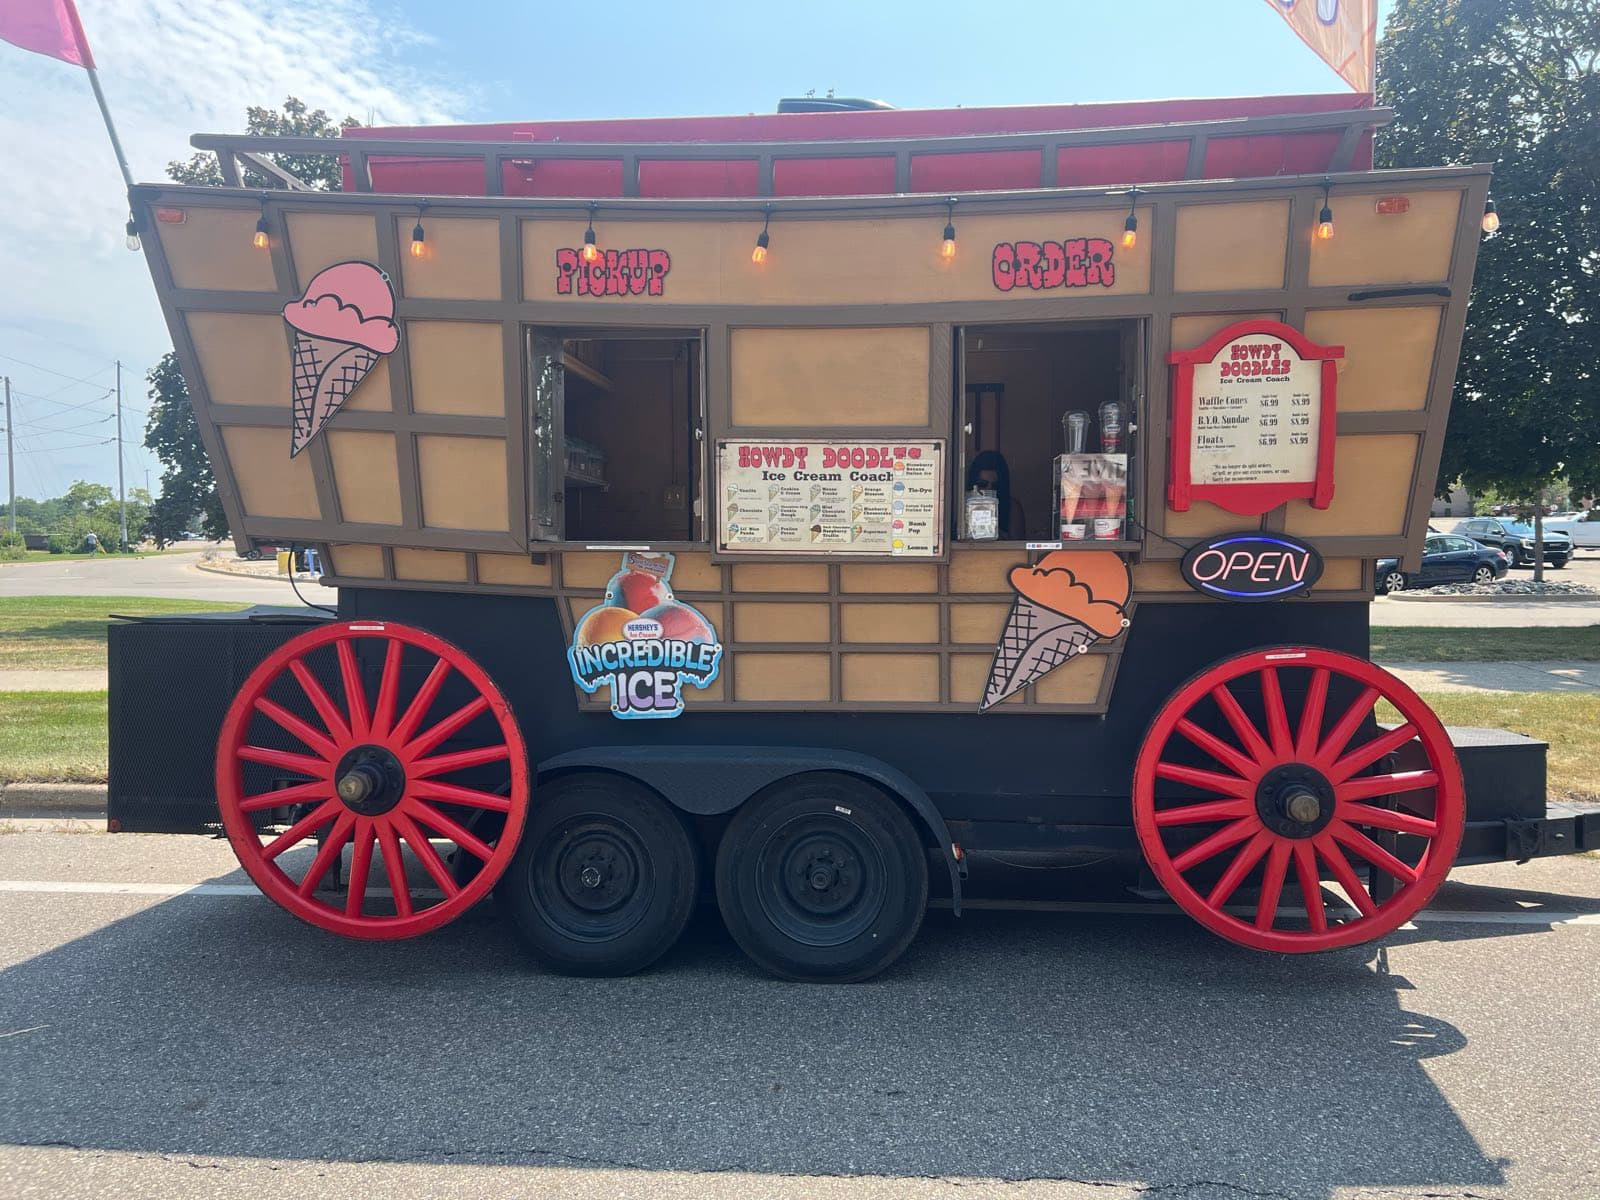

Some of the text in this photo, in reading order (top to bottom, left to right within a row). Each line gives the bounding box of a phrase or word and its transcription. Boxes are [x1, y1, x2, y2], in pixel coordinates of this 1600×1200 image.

[556, 248, 671, 297] PICKUP
[992, 238, 1115, 291] ORDER
[1231, 344, 1281, 360] HOWDY
[1220, 359, 1291, 377] DOODLES
[1199, 396, 1224, 405] Waffle
[1226, 396, 1248, 405] Cones
[1222, 414, 1250, 424] Sundae
[1197, 435, 1223, 444] Floats
[738, 446, 808, 469] HOWDY
[762, 471, 786, 481] Ice
[794, 471, 842, 481] Cream
[1192, 549, 1310, 582] OPEN
[627, 623, 658, 632] HERSHEY'S
[575, 639, 717, 676] INCREDIBLE
[617, 671, 678, 709] ICE
